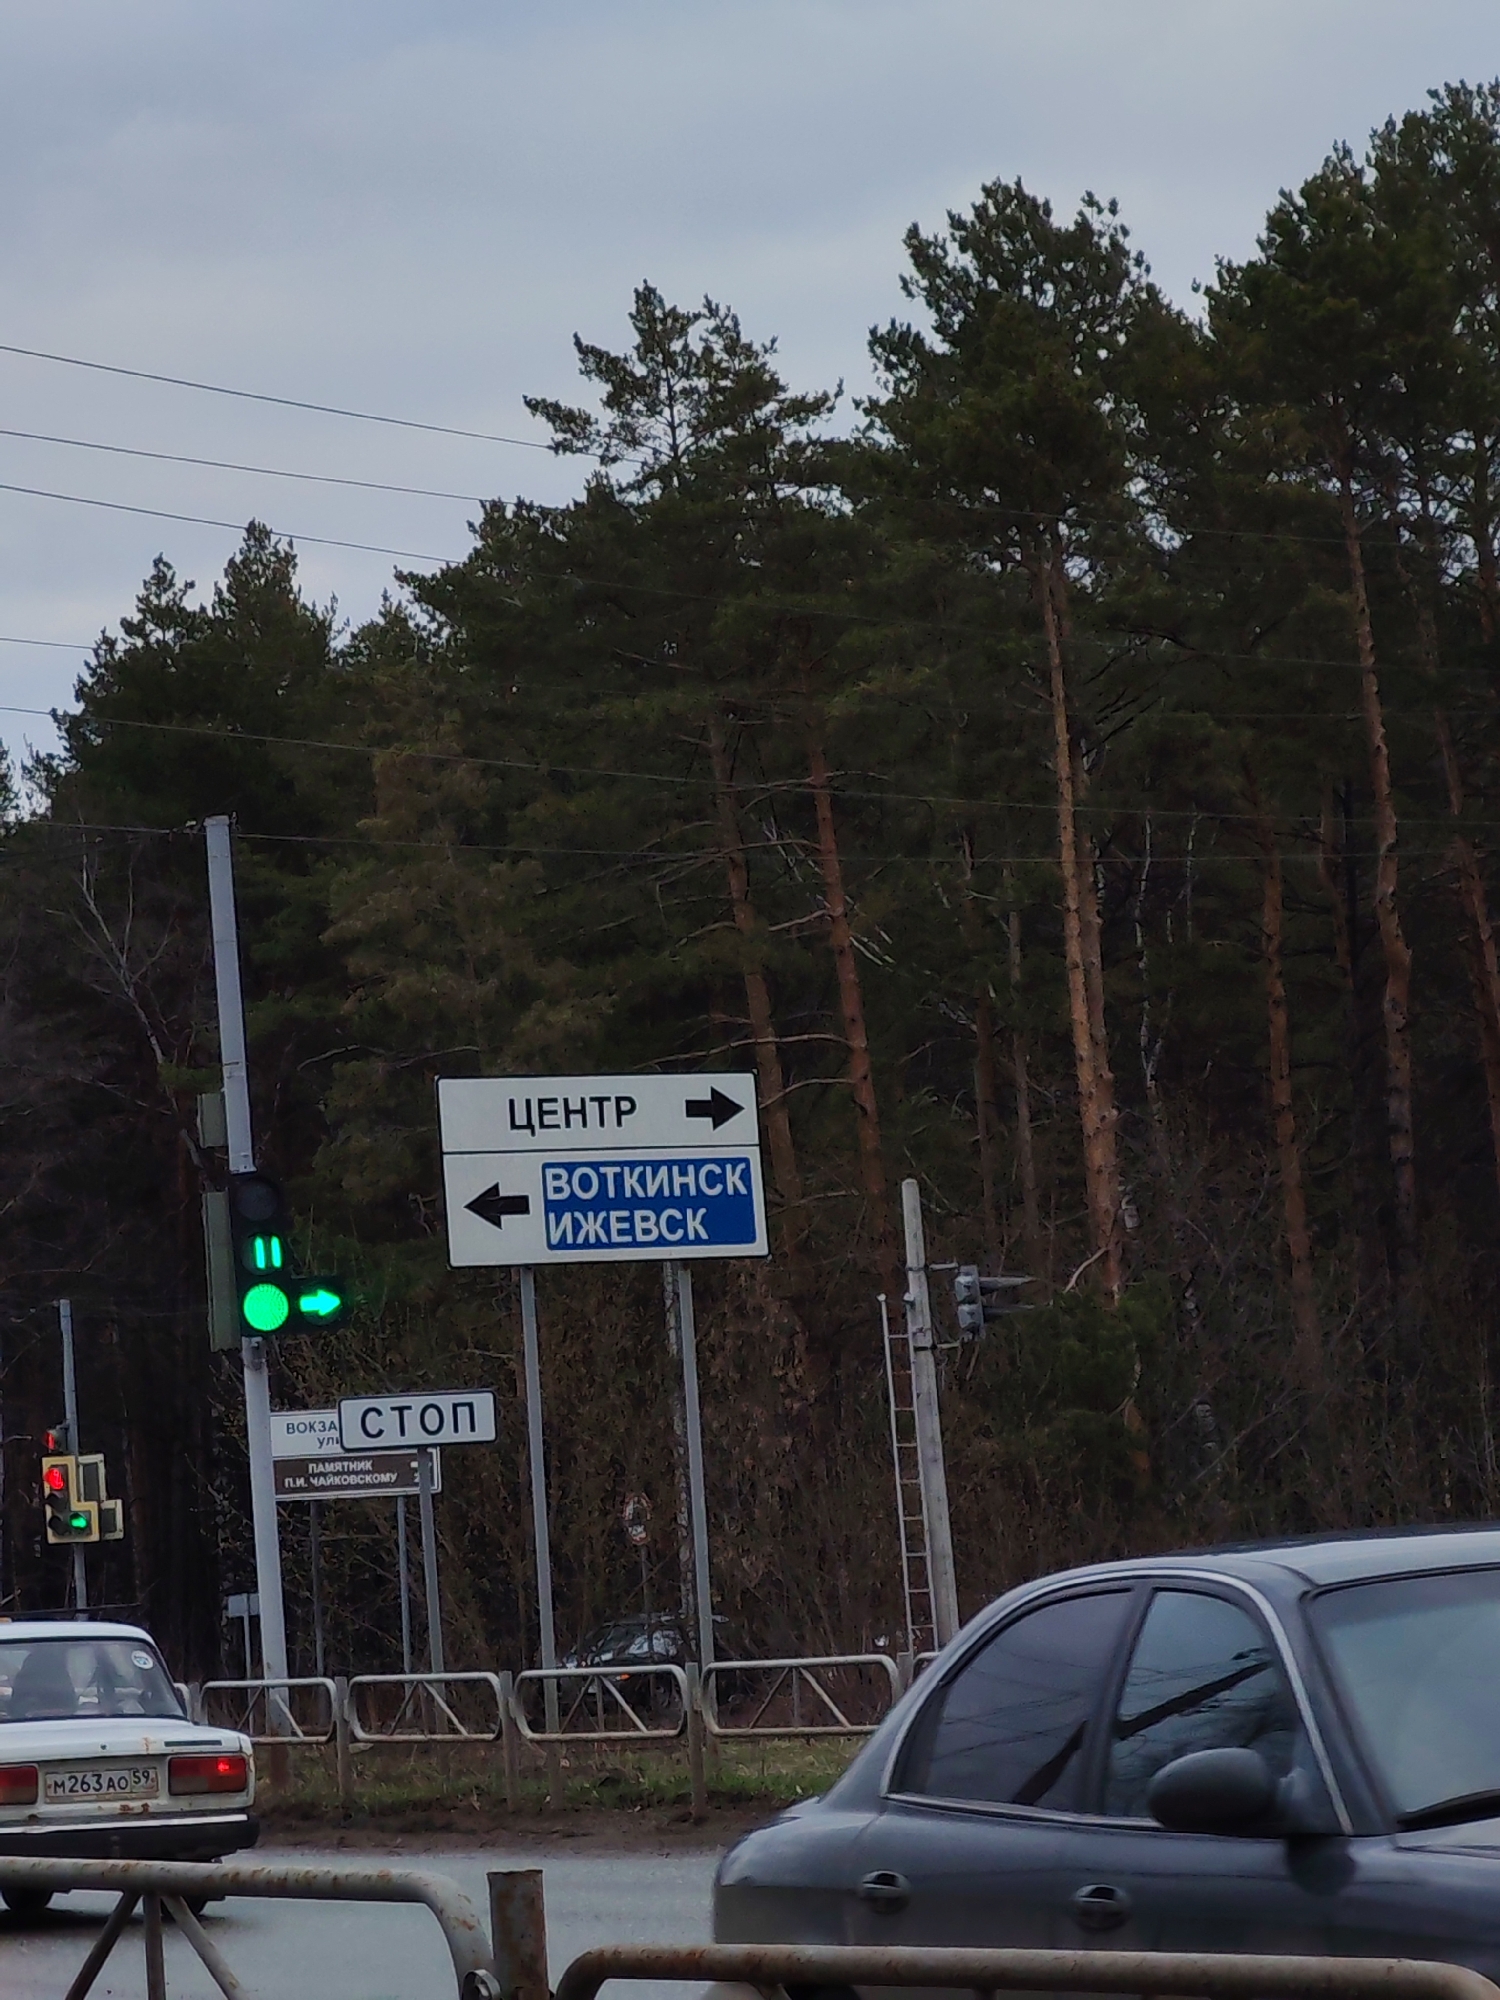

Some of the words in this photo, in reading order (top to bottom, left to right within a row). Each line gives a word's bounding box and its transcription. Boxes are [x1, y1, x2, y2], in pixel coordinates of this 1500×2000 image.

[508, 1095, 637, 1137] ЦЕНТР
[544, 1162, 748, 1200] ВОТКИНСК
[549, 1207, 709, 1245] ИЖЕВСК
[360, 1401, 476, 1439] СТОП
[284, 1477, 308, 1488] П.И.
[309, 1472, 398, 1487] ЧАЙКОВСКОМУ
[308, 1460, 373, 1474] ПАМЯТНИК
